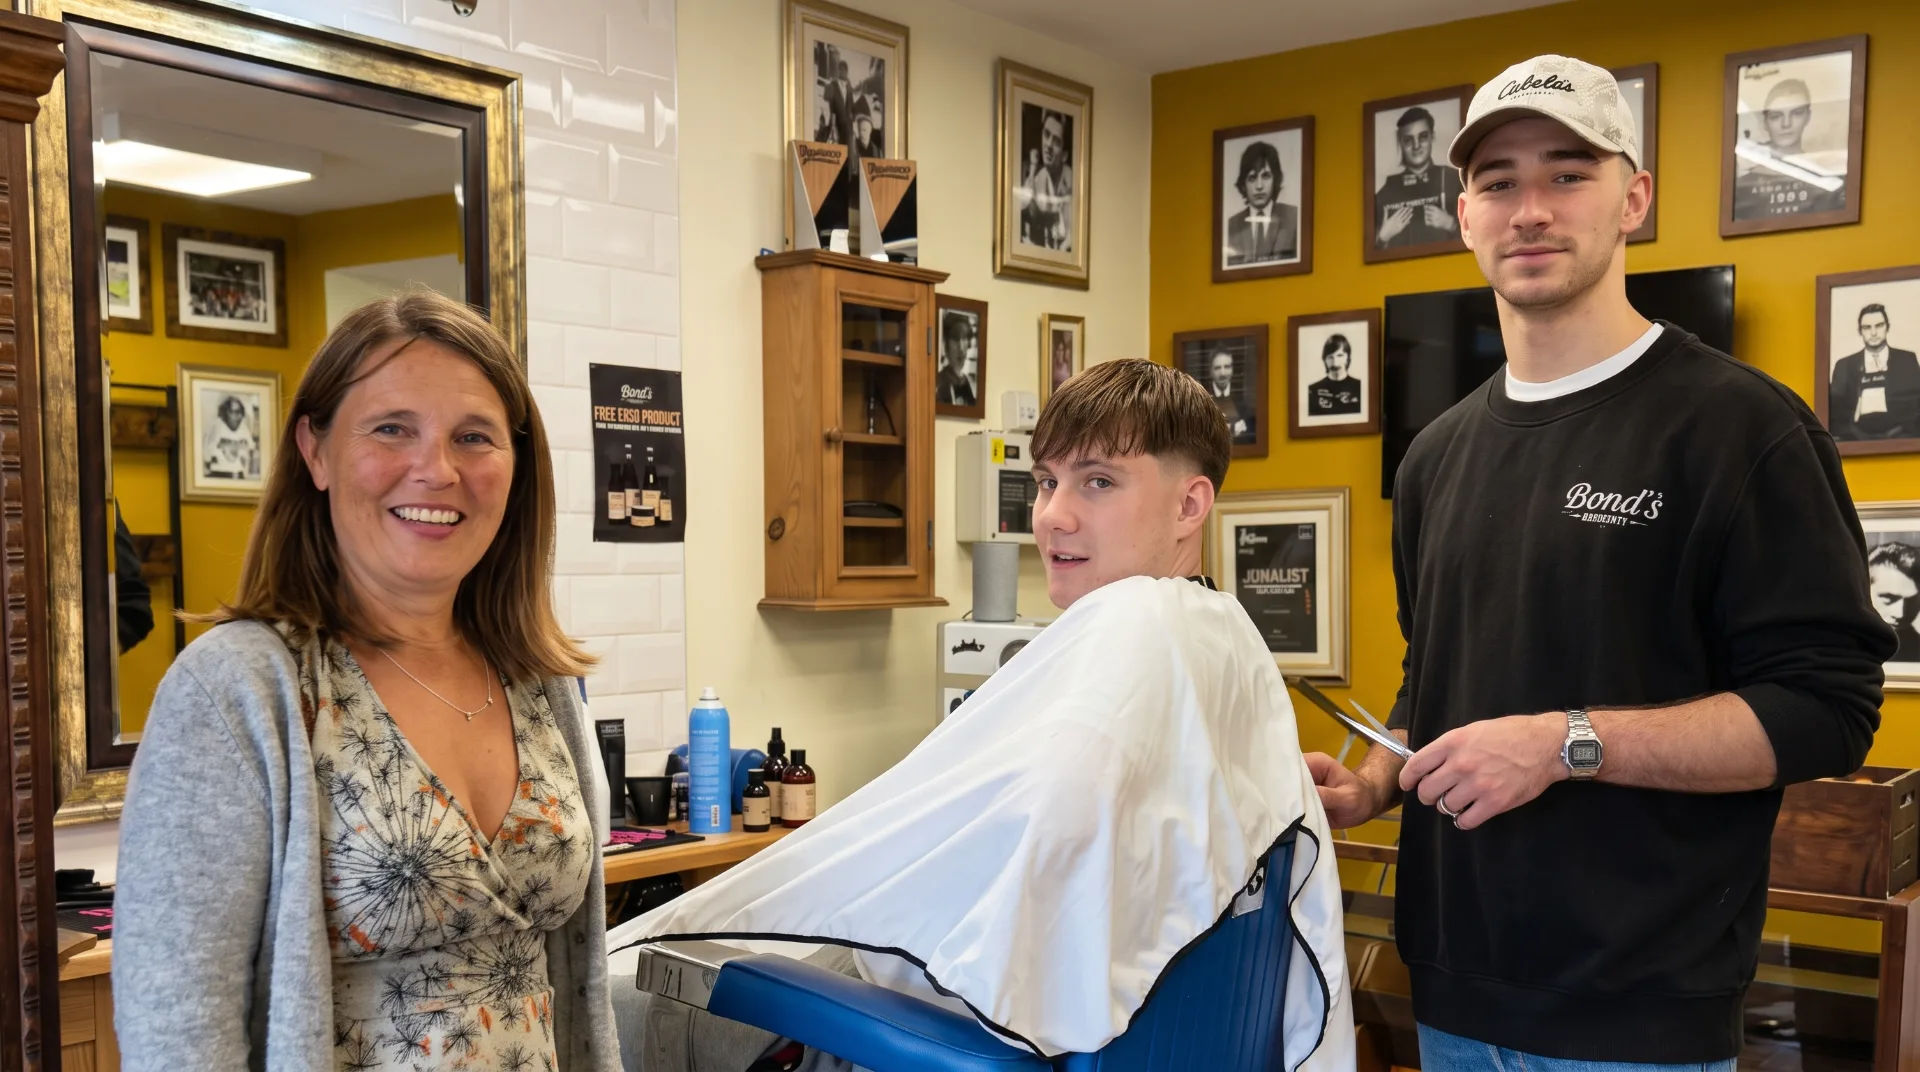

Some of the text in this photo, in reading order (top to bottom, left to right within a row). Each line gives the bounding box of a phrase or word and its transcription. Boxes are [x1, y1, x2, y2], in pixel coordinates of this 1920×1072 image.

[621, 384, 653, 400] Bond's
[594, 405, 617, 422] FREE
[641, 409, 681, 427] PRODUCT
[1564, 482, 1663, 519] Bond's
